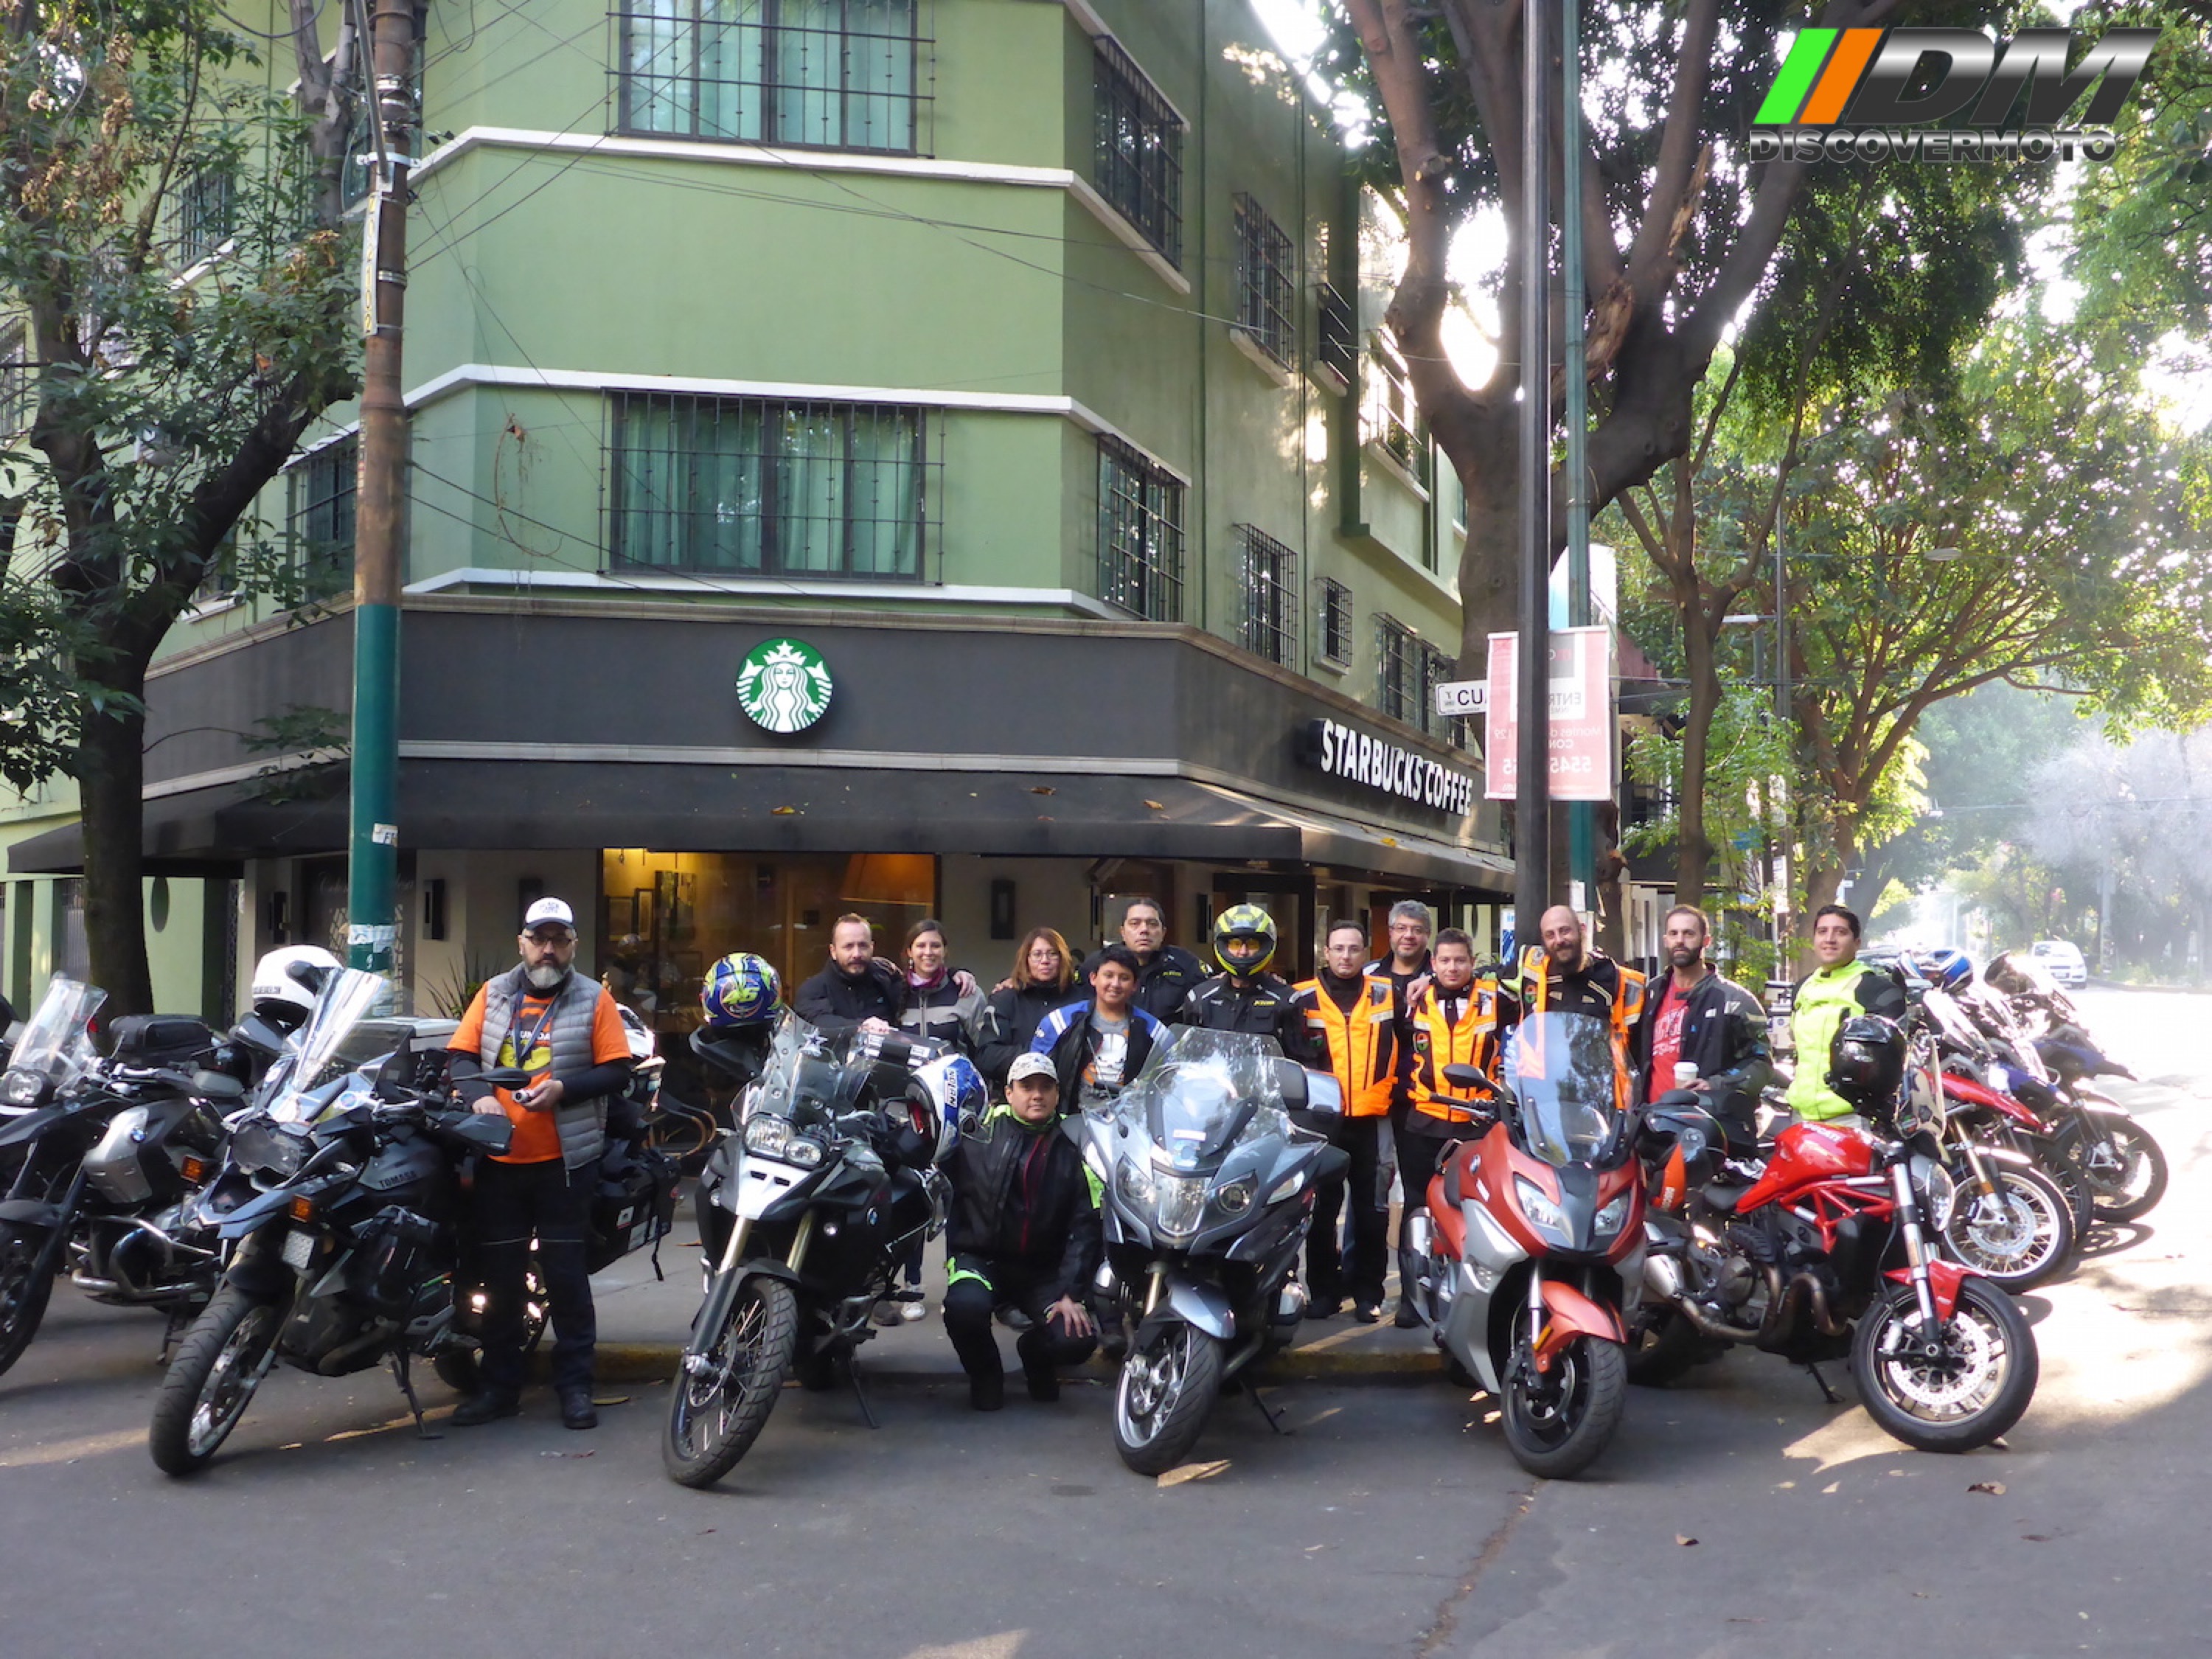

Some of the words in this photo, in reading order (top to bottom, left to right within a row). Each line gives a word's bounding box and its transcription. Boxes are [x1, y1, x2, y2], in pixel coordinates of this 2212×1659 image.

[1458, 688, 1486, 706] CU
[1321, 718, 1423, 801] STARBUCKS
[1424, 760, 1473, 816] COFFEE
